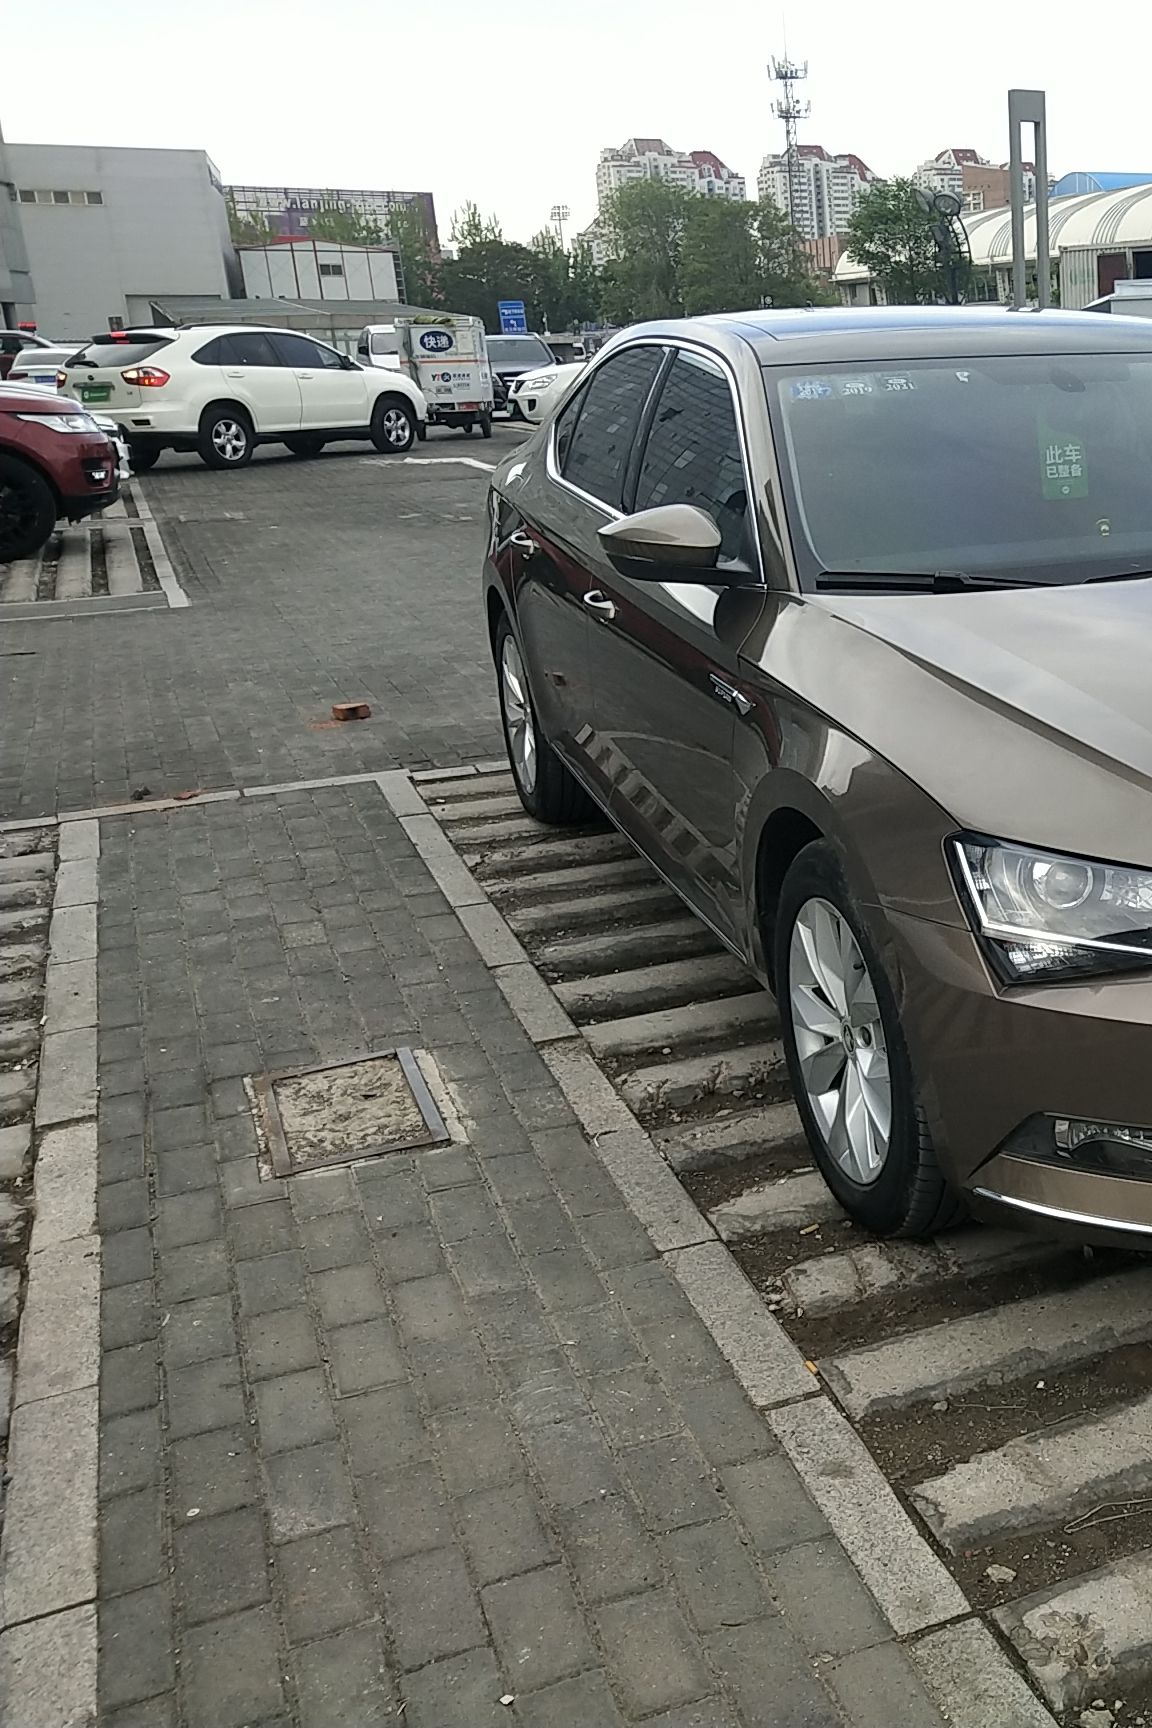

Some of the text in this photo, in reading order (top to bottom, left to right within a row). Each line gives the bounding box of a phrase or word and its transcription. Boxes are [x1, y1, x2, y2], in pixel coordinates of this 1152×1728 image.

[424, 335, 450, 349] 快递
[1046, 443, 1082, 465] 此车
[1046, 464, 1082, 479] 已整备
